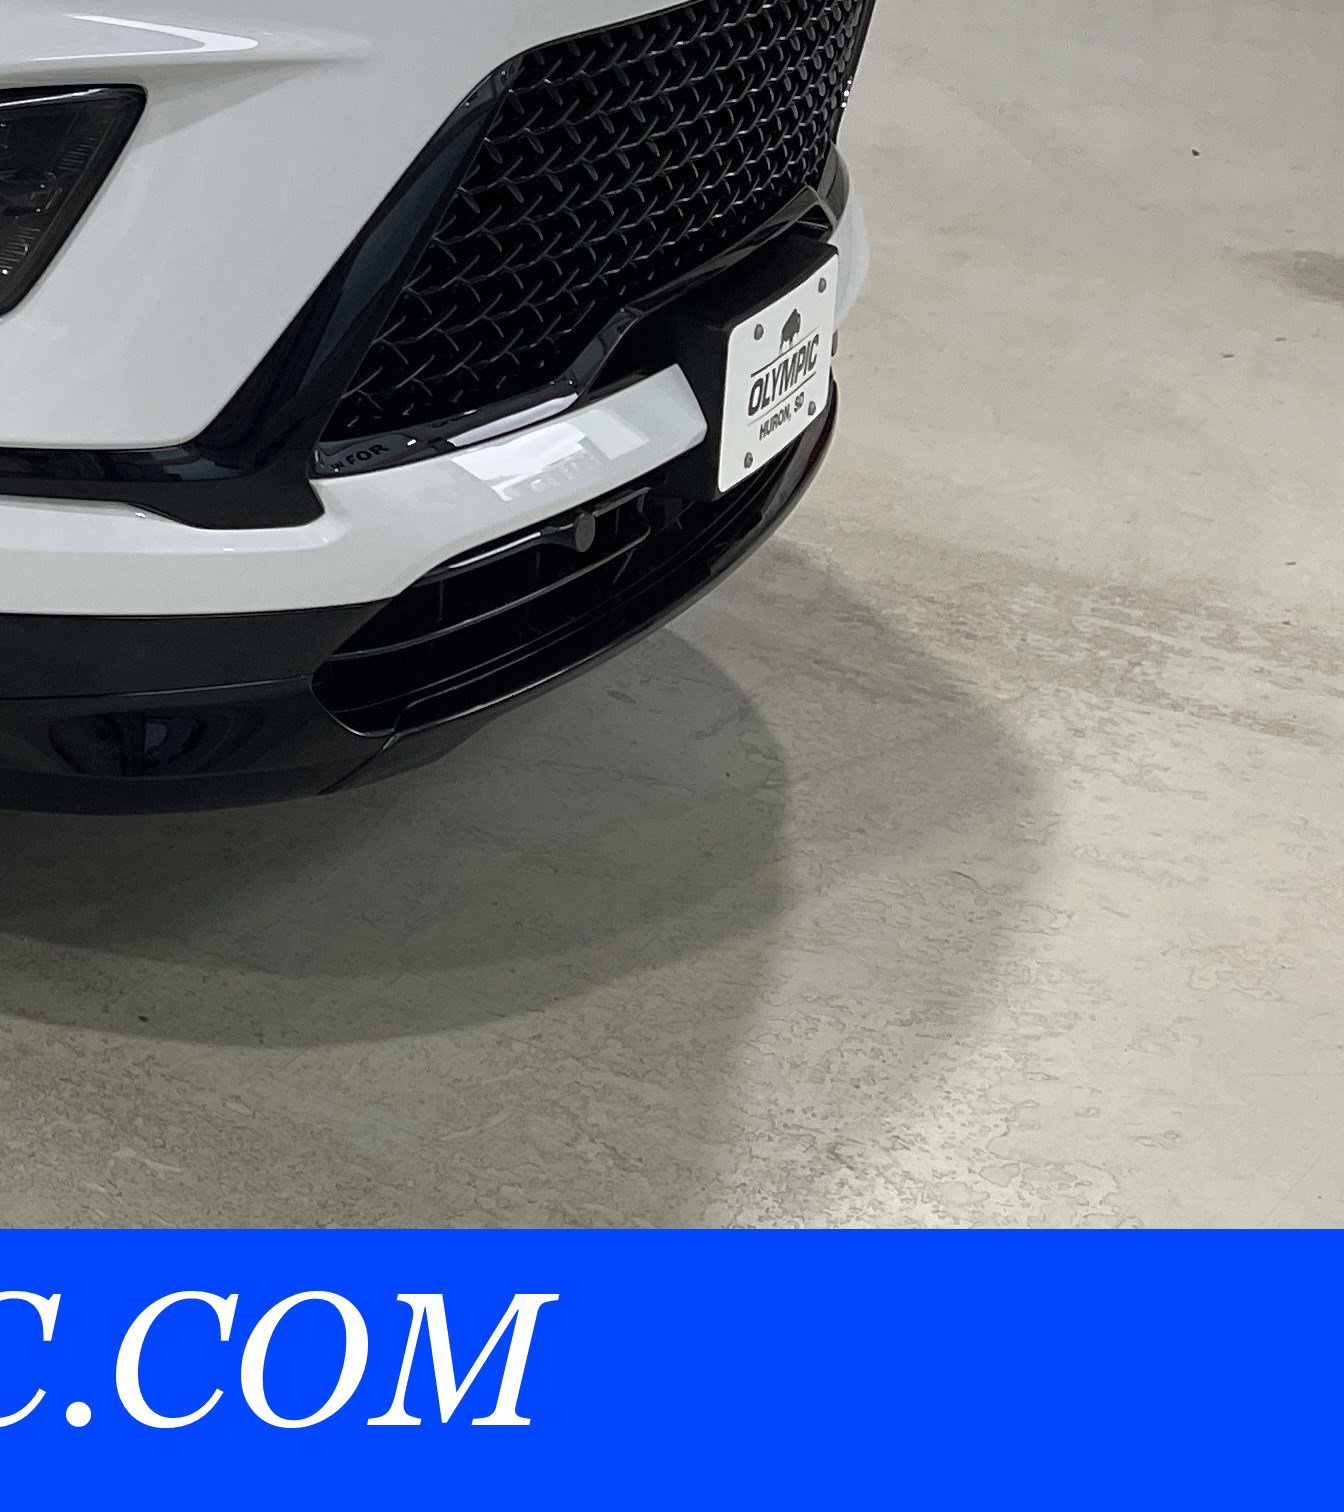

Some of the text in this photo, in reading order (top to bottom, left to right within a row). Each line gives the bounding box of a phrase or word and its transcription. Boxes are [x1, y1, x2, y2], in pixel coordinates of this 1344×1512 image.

[747, 334, 820, 417] OLYMPIC
[759, 392, 805, 441] HURON, SD
